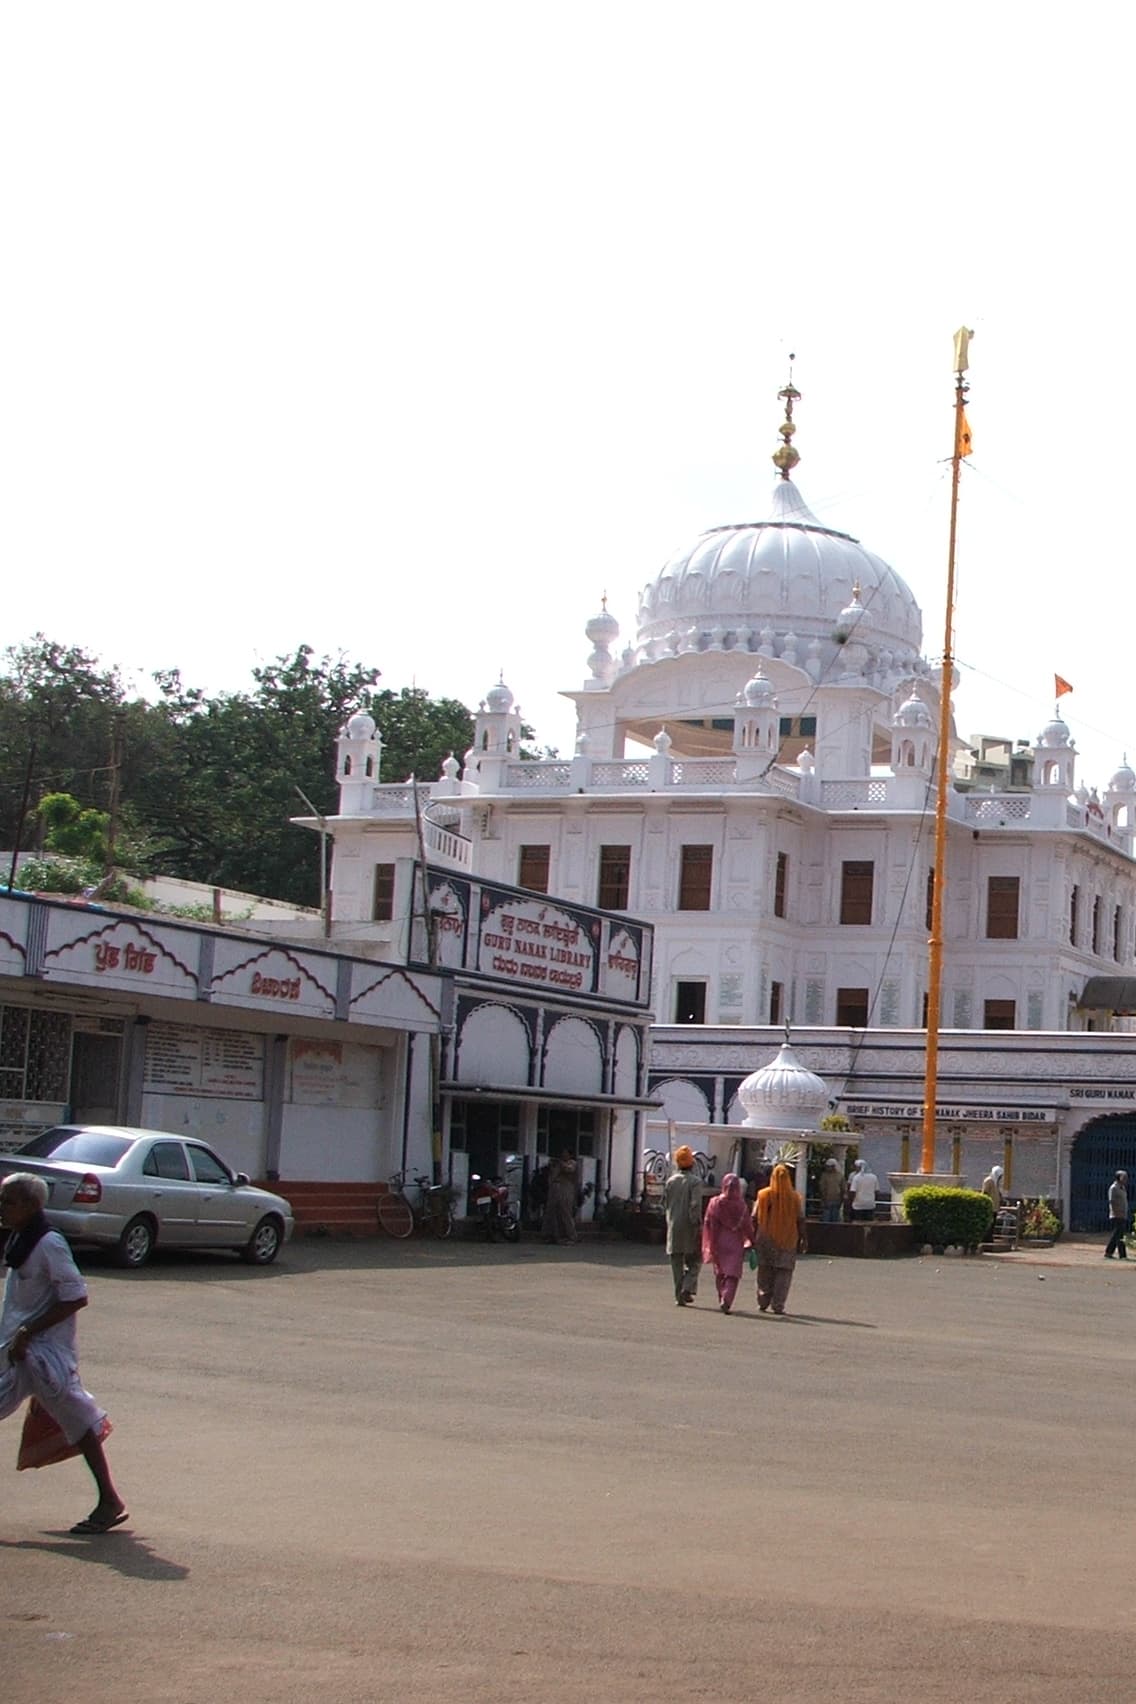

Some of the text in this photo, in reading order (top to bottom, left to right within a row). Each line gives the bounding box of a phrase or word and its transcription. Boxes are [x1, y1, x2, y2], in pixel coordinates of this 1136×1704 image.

[484, 933, 591, 969] GURU NANAK LIBRARY
[1070, 1088, 1084, 1099] SRI
[1085, 1089, 1106, 1099] GURU
[1107, 1090, 1136, 1100] NANAK
[846, 1105, 869, 1114] BRIEF
[872, 1106, 904, 1116] HISTORY
[906, 1107, 918, 1116] OF
[996, 1110, 1020, 1120] SAHIB
[1022, 1111, 1046, 1121] BIDAR
